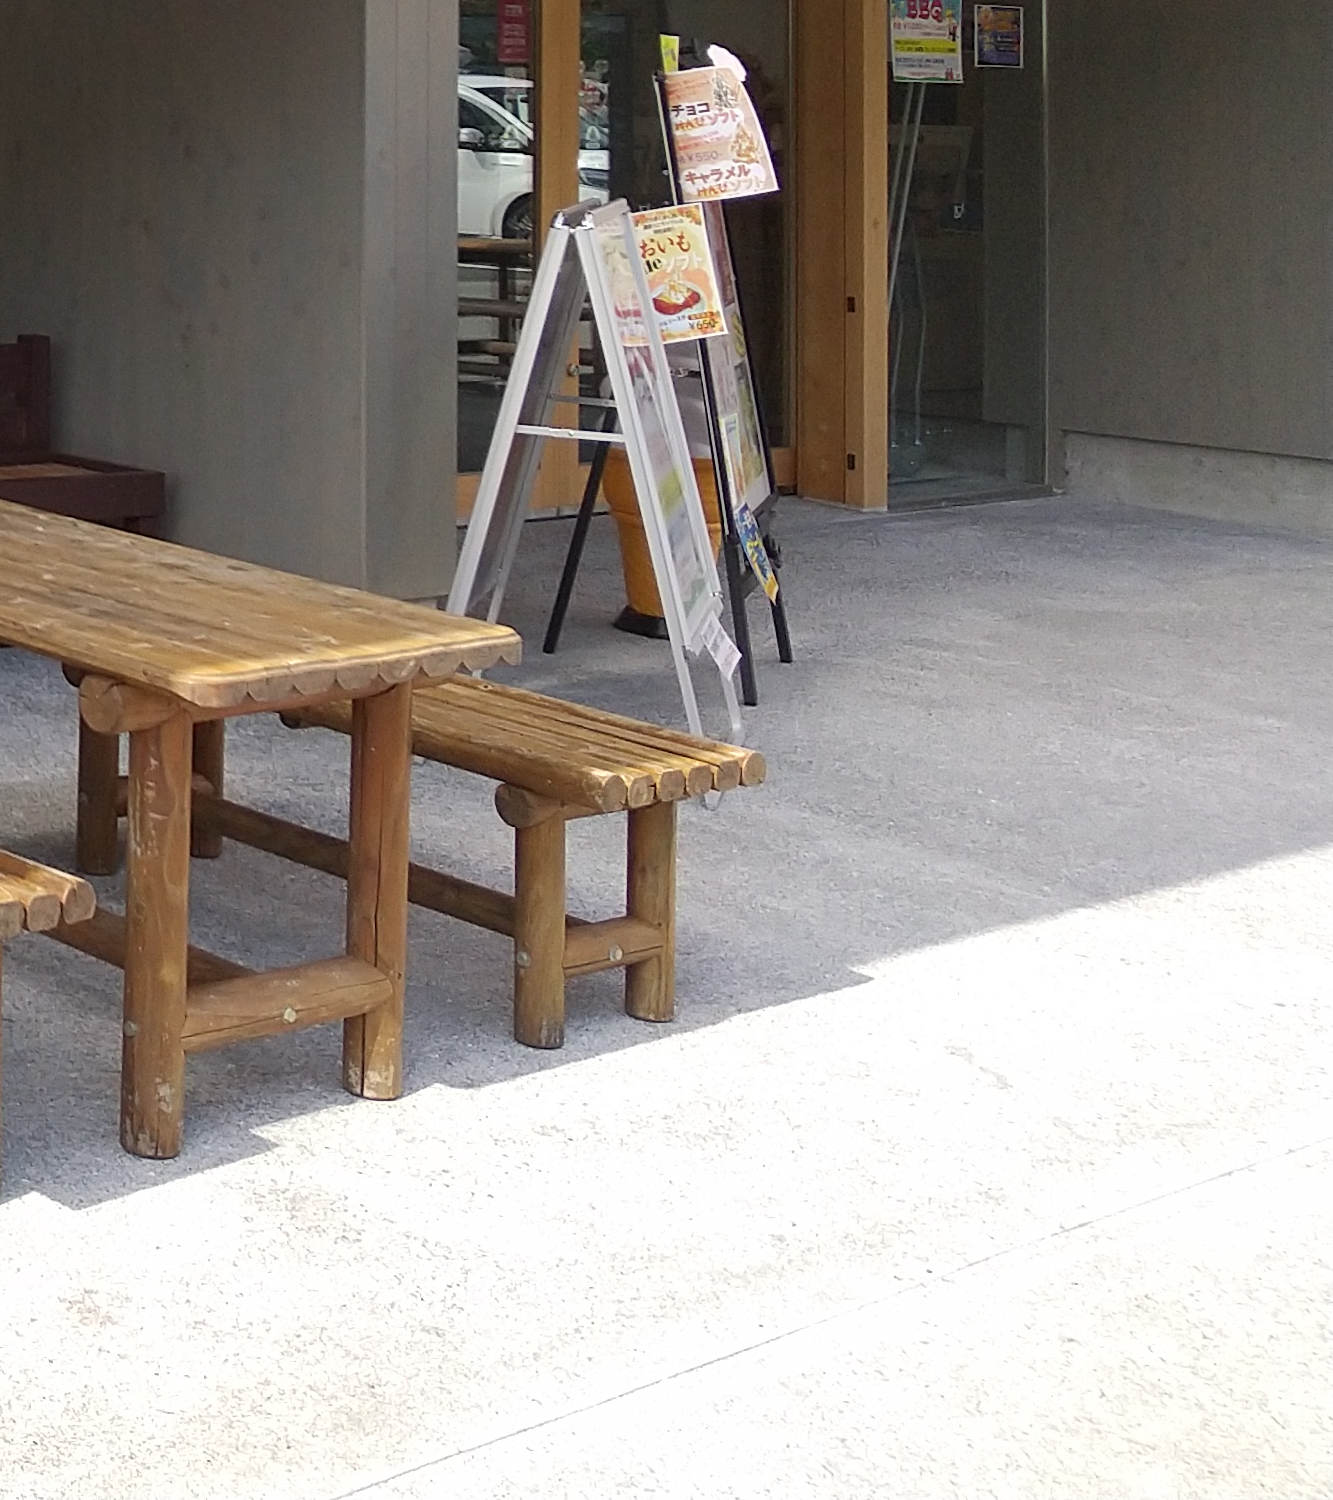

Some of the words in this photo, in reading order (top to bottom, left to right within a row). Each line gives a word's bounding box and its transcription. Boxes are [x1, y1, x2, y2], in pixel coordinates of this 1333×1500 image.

[670, 102, 710, 118] チョコ
[685, 166, 751, 185] キャラメル
[639, 231, 691, 259] おいも
